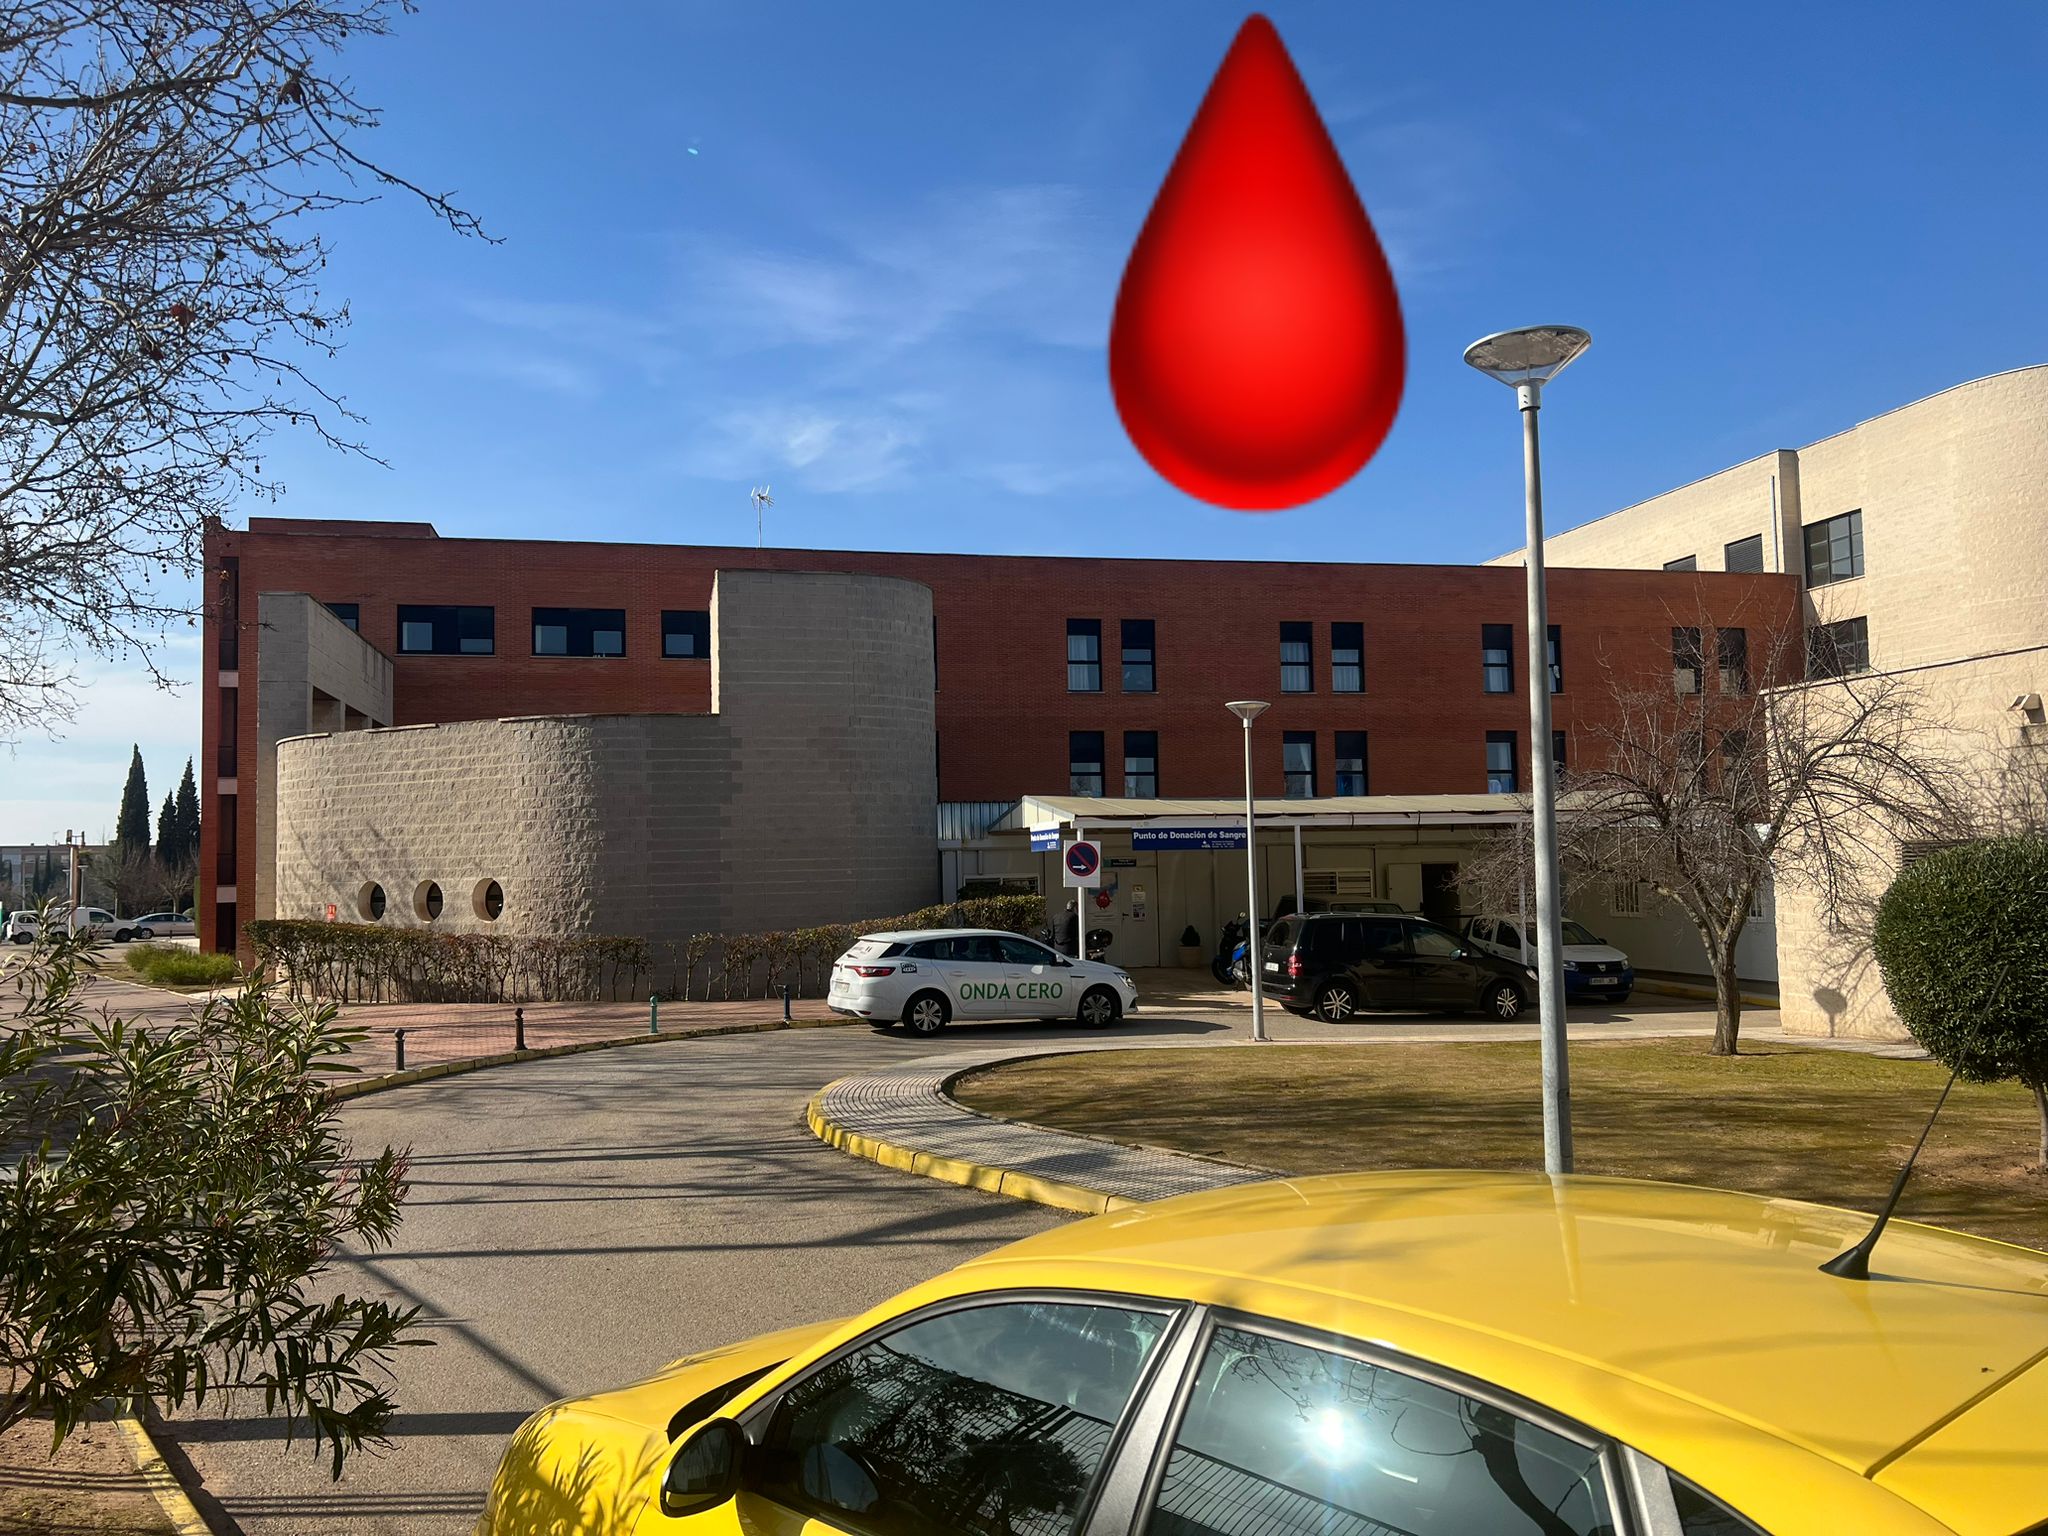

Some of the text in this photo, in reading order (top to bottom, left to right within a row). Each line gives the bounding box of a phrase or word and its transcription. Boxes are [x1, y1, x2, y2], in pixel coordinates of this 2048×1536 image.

[1133, 830, 1246, 840] Punto de Donación de Sangre
[960, 982, 1063, 1000] ONDA CERO
